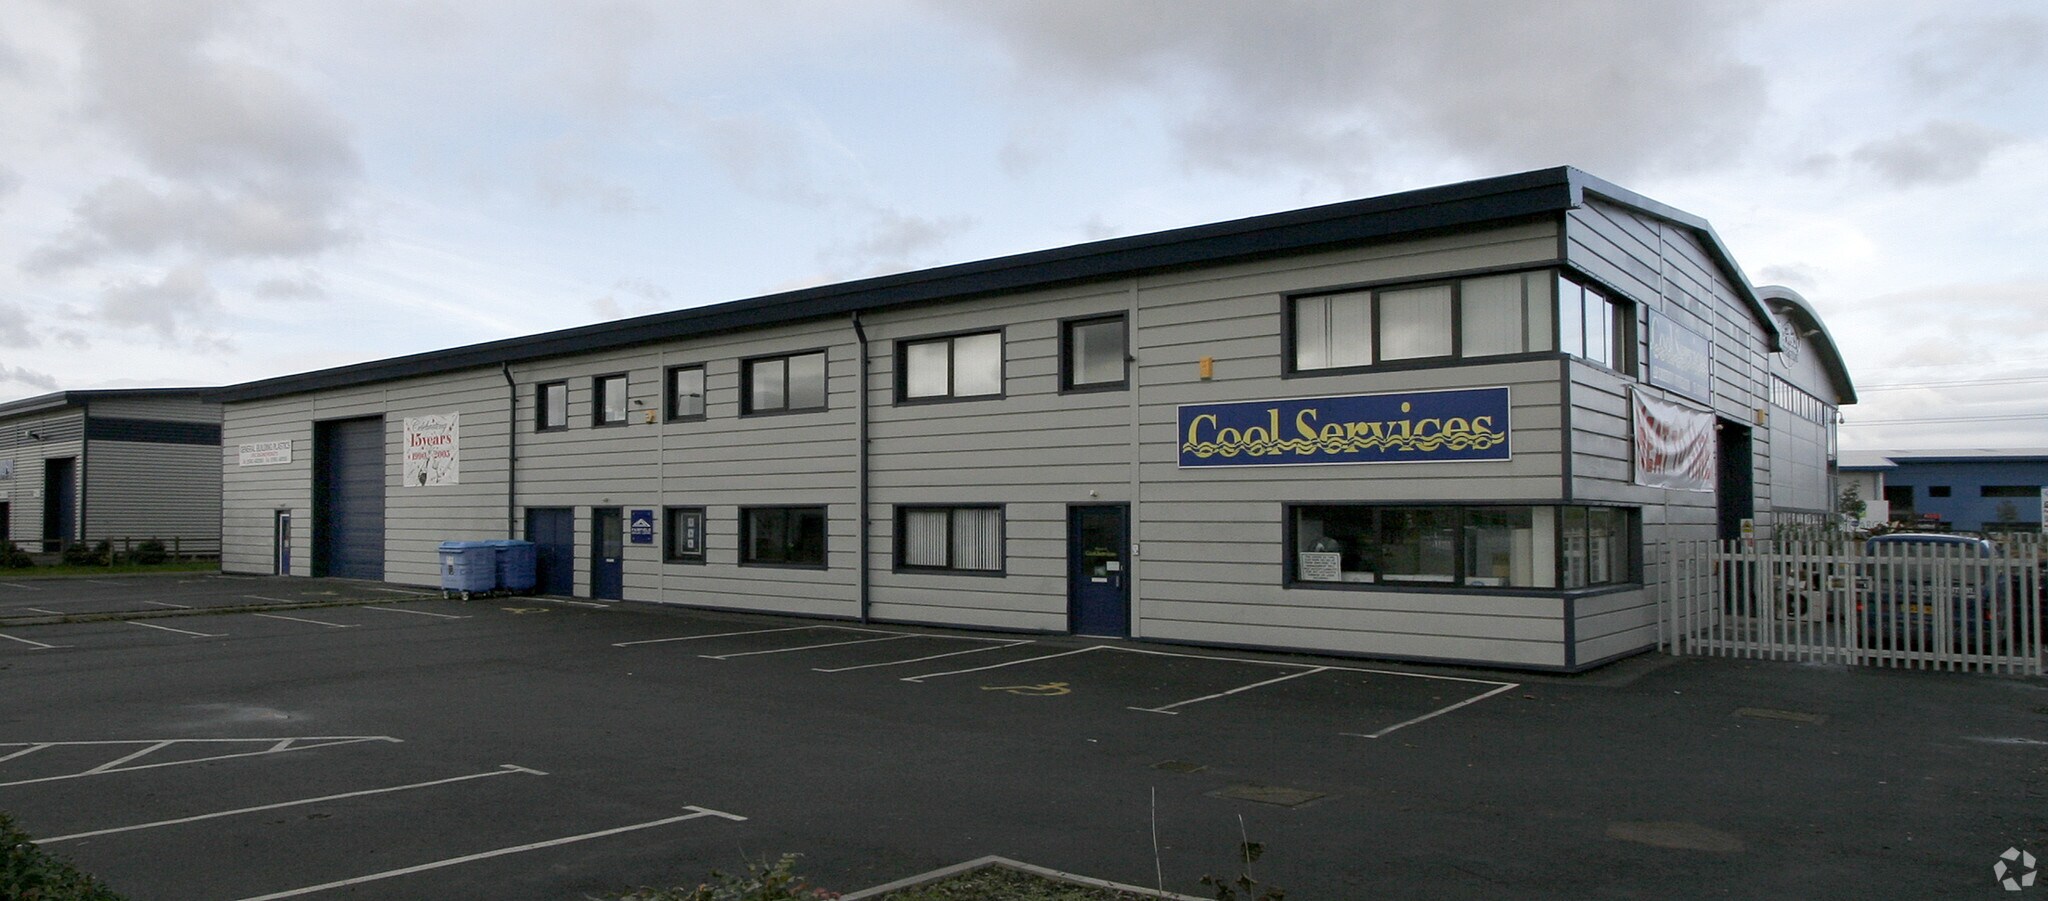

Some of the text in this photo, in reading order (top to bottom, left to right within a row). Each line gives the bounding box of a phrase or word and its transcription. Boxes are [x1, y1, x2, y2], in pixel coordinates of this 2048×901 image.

[1187, 402, 1493, 458] Cool Services
[433, 450, 451, 459] 2005
